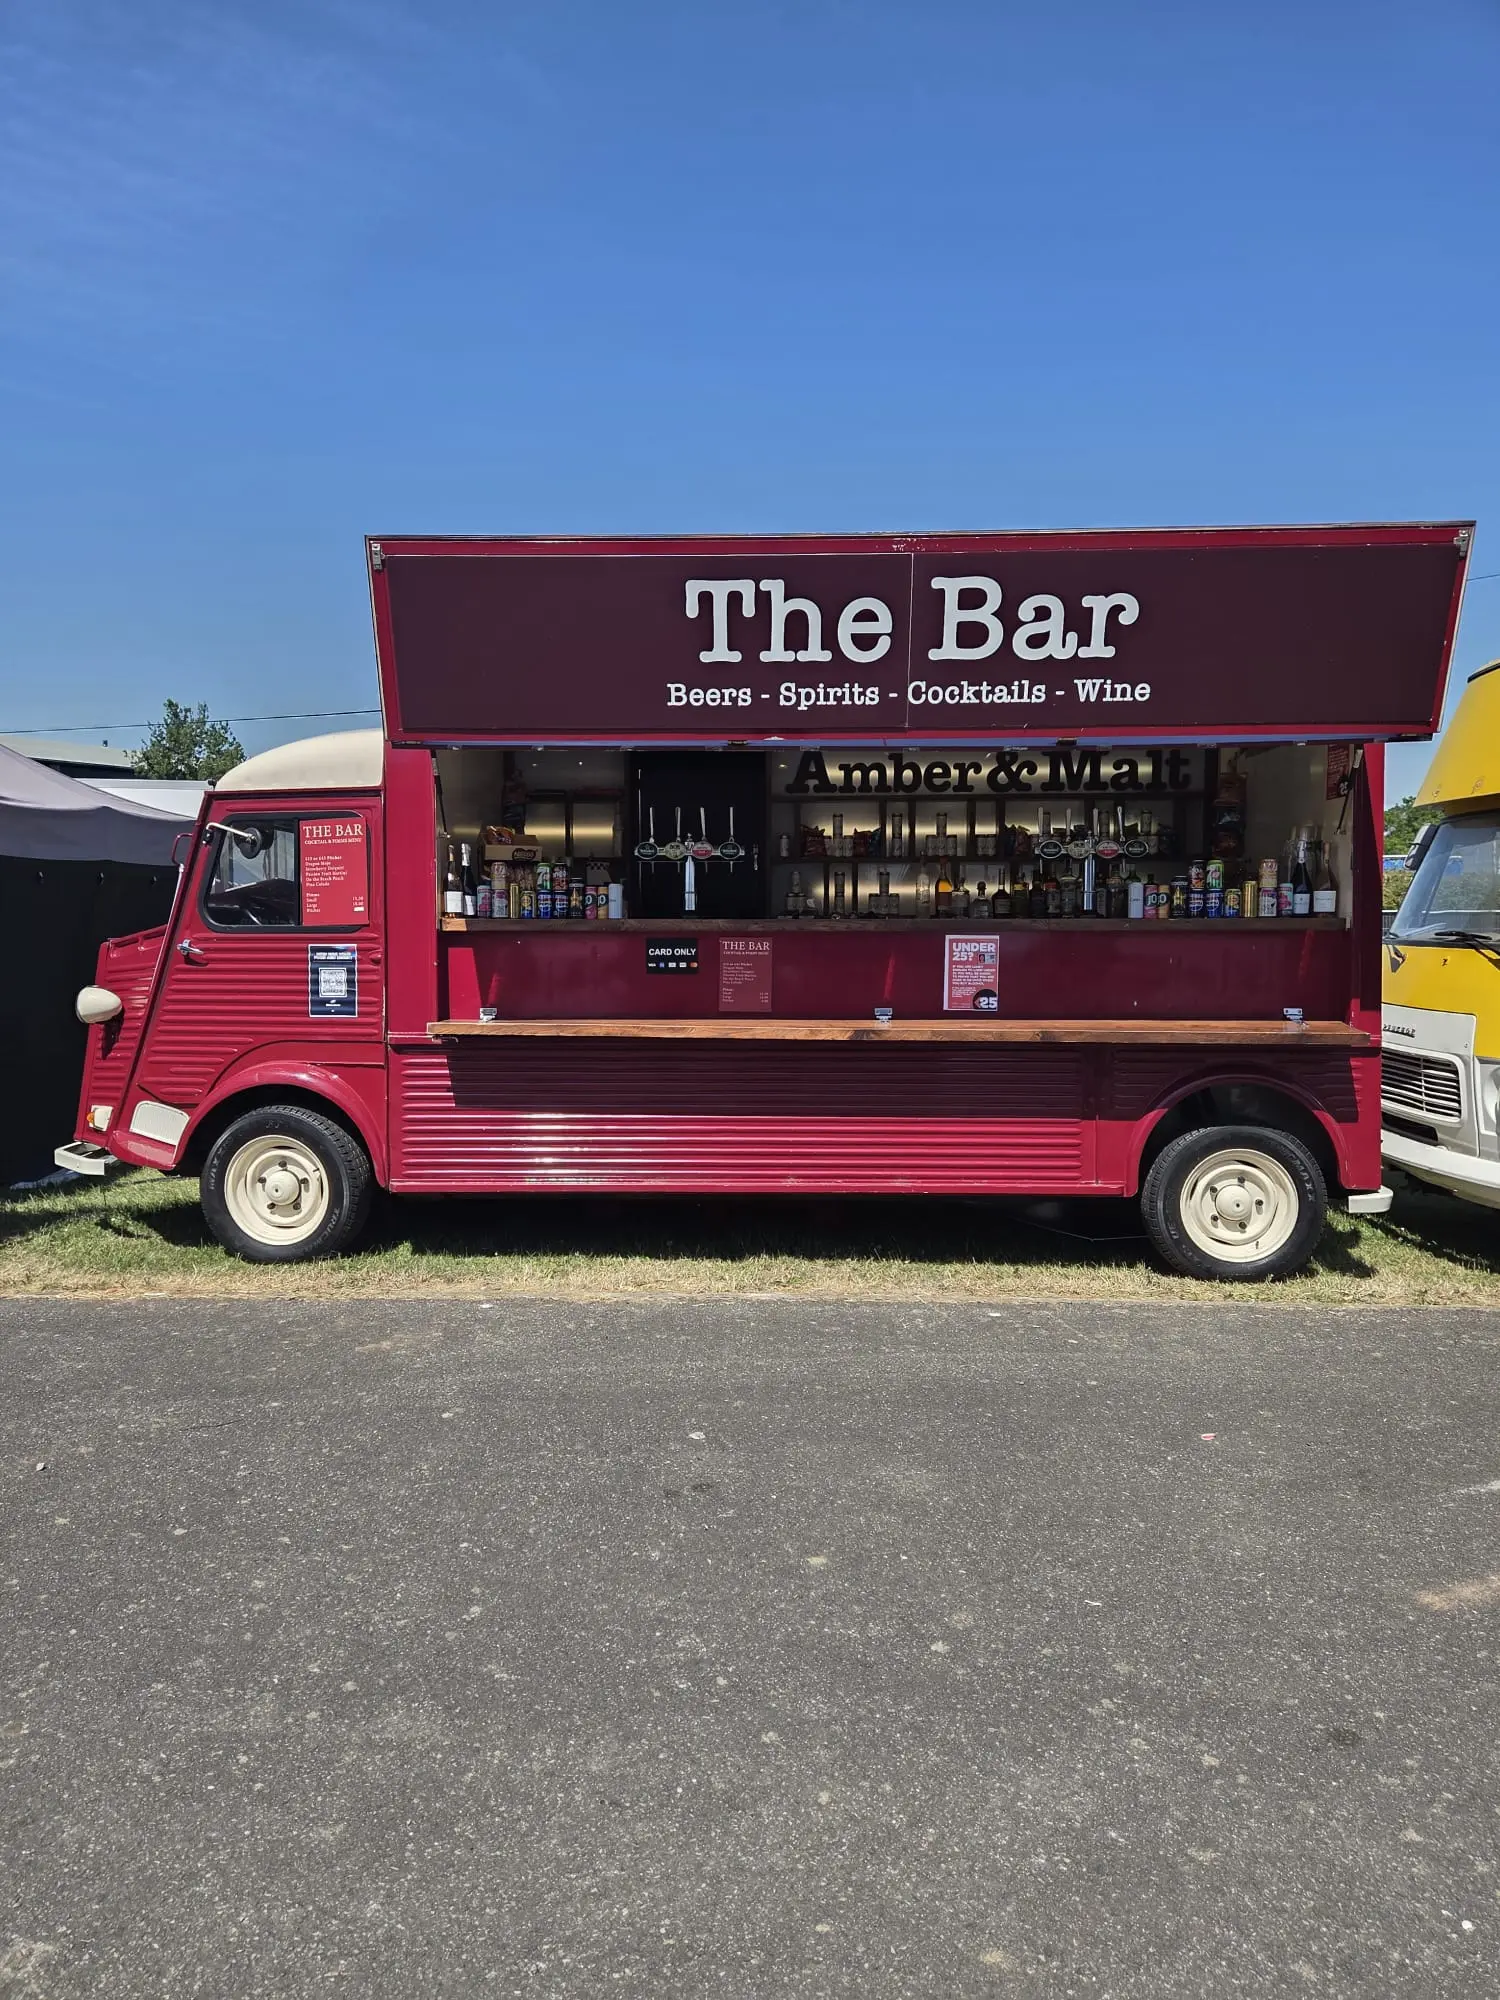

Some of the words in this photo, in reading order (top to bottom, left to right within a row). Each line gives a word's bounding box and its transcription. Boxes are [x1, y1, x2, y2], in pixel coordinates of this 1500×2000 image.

[685, 579, 893, 663] The
[928, 575, 1139, 661] Bar
[667, 682, 752, 706] Beers
[779, 681, 880, 711] Spirits
[907, 680, 1046, 705] Cocktails
[1074, 678, 1150, 703] Wine
[303, 825, 331, 838] THE
[335, 823, 364, 836] BAR
[722, 941, 746, 950] THE
[748, 942, 770, 951] BAR
[952, 942, 996, 952] UNDER
[952, 952, 974, 961] 25?
[980, 997, 997, 1008] 25
